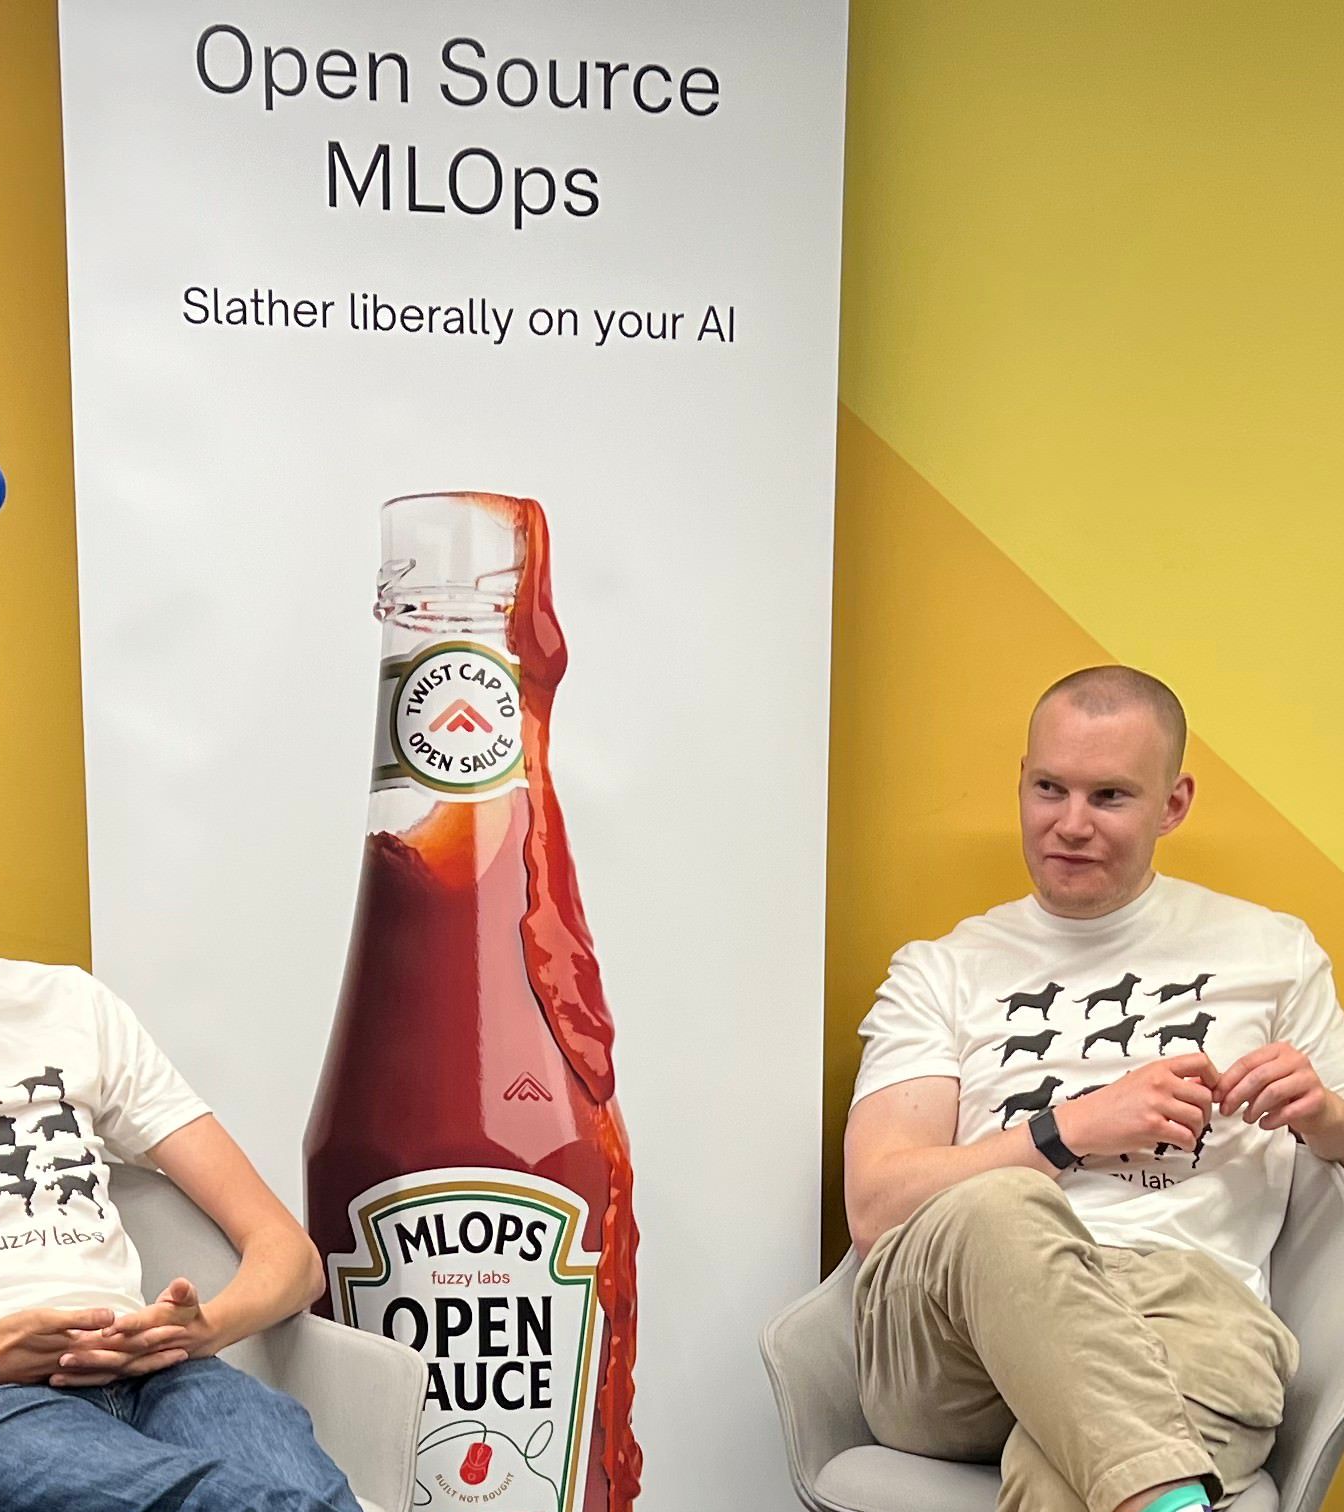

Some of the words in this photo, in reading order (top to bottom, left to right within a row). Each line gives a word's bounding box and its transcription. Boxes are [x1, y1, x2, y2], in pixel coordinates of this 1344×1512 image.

[196, 24, 409, 111] Open
[440, 37, 721, 117] Source
[327, 140, 600, 230] MLOps
[183, 286, 335, 329] Slather
[350, 292, 514, 345] liberally
[528, 309, 579, 337] on
[593, 309, 686, 347] your
[697, 305, 736, 343] AI
[406, 663, 453, 716] TWIST
[459, 663, 502, 690] CAP
[497, 692, 516, 718] TO
[408, 732, 454, 772] OPEN
[460, 734, 514, 774] SAUCE
[53, 1226, 105, 1246] labs
[394, 1211, 548, 1265] MLOPS
[431, 1271, 473, 1288] fuzzy
[477, 1270, 512, 1285] labs
[382, 1296, 553, 1358] OPEN
[422, 1361, 553, 1412] AUCE
[435, 1473, 457, 1497] BUILT
[459, 1494, 480, 1504] NOT
[482, 1471, 515, 1502] BOUGHT
